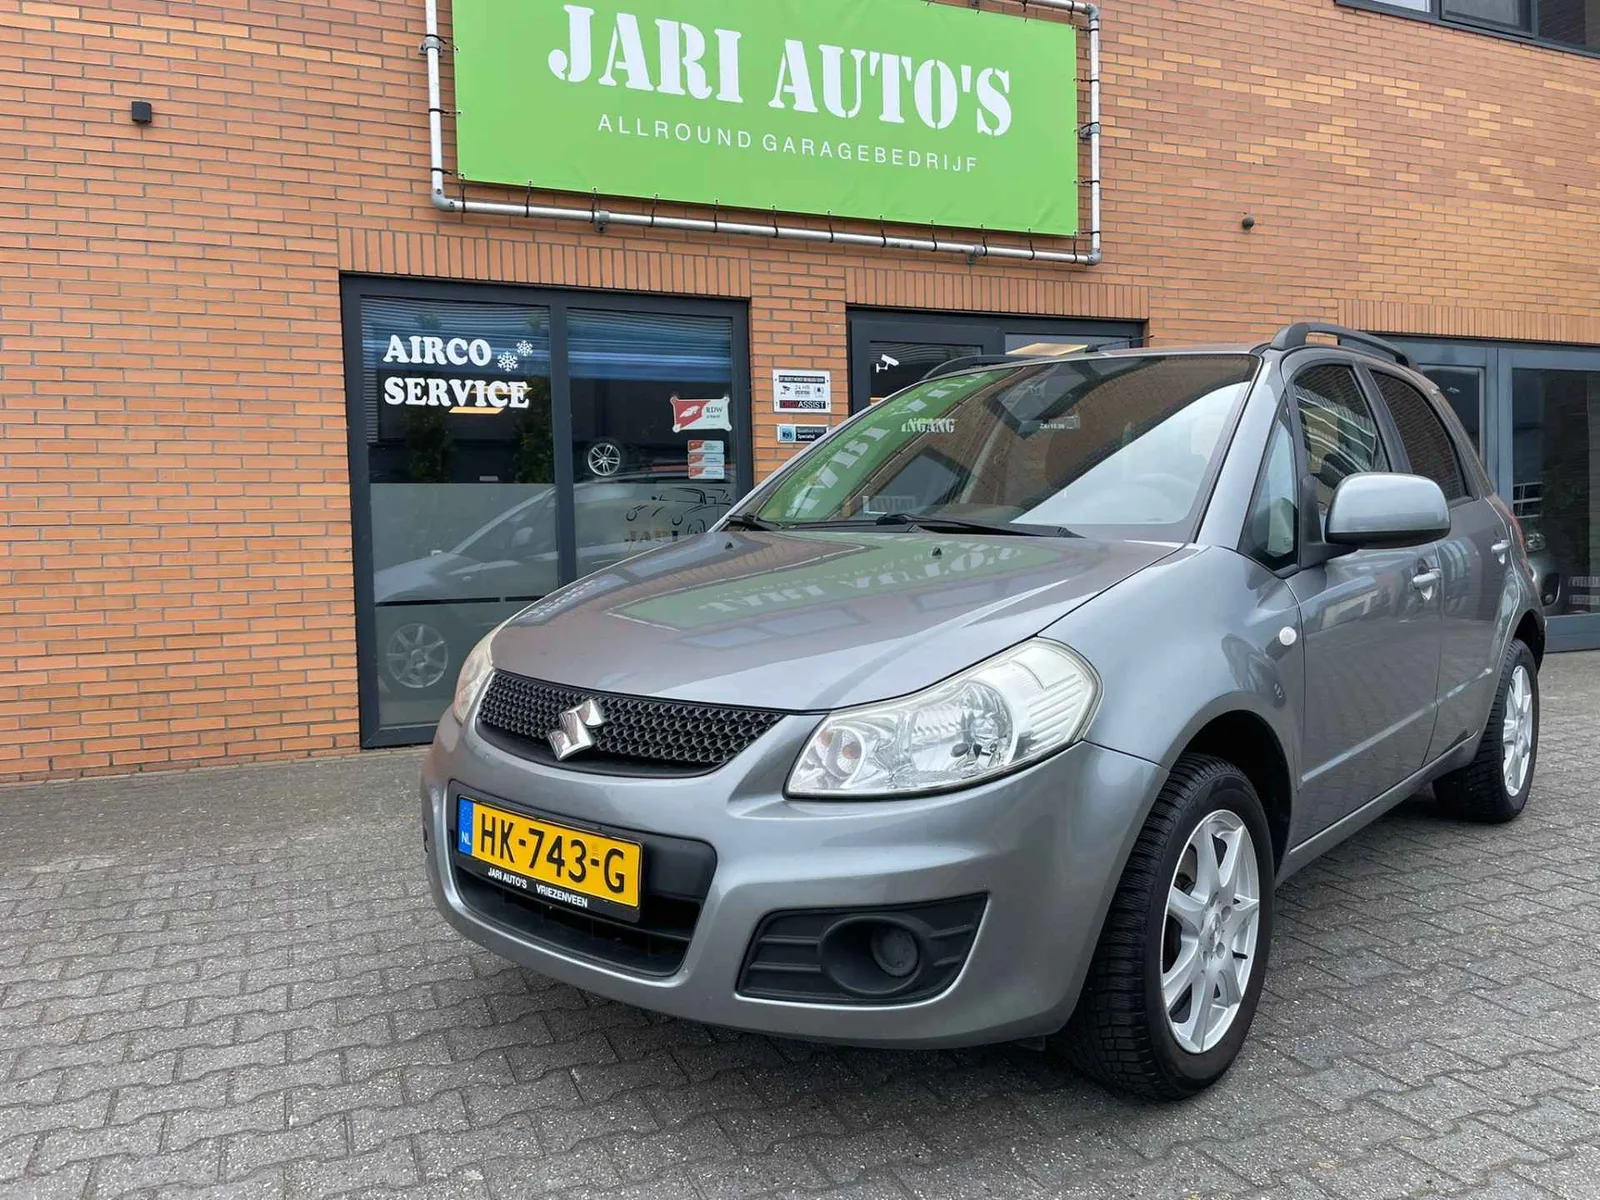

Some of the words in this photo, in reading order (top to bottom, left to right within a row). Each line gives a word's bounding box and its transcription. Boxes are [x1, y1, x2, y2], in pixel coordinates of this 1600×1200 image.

[548, 4, 744, 104] JARI
[768, 38, 1013, 137] AUTO'S
[598, 114, 752, 148] ALLROUND
[762, 134, 979, 173] GARAGEBEDRIJF
[383, 334, 492, 366] AIRCO
[384, 376, 530, 409] SERVICE
[461, 832, 471, 846] NL
[481, 813, 625, 894] HK-743-G
[488, 866, 502, 880] JARI
[503, 873, 527, 889] AUTO'S
[536, 883, 588, 908] VRIEZENVEEN
